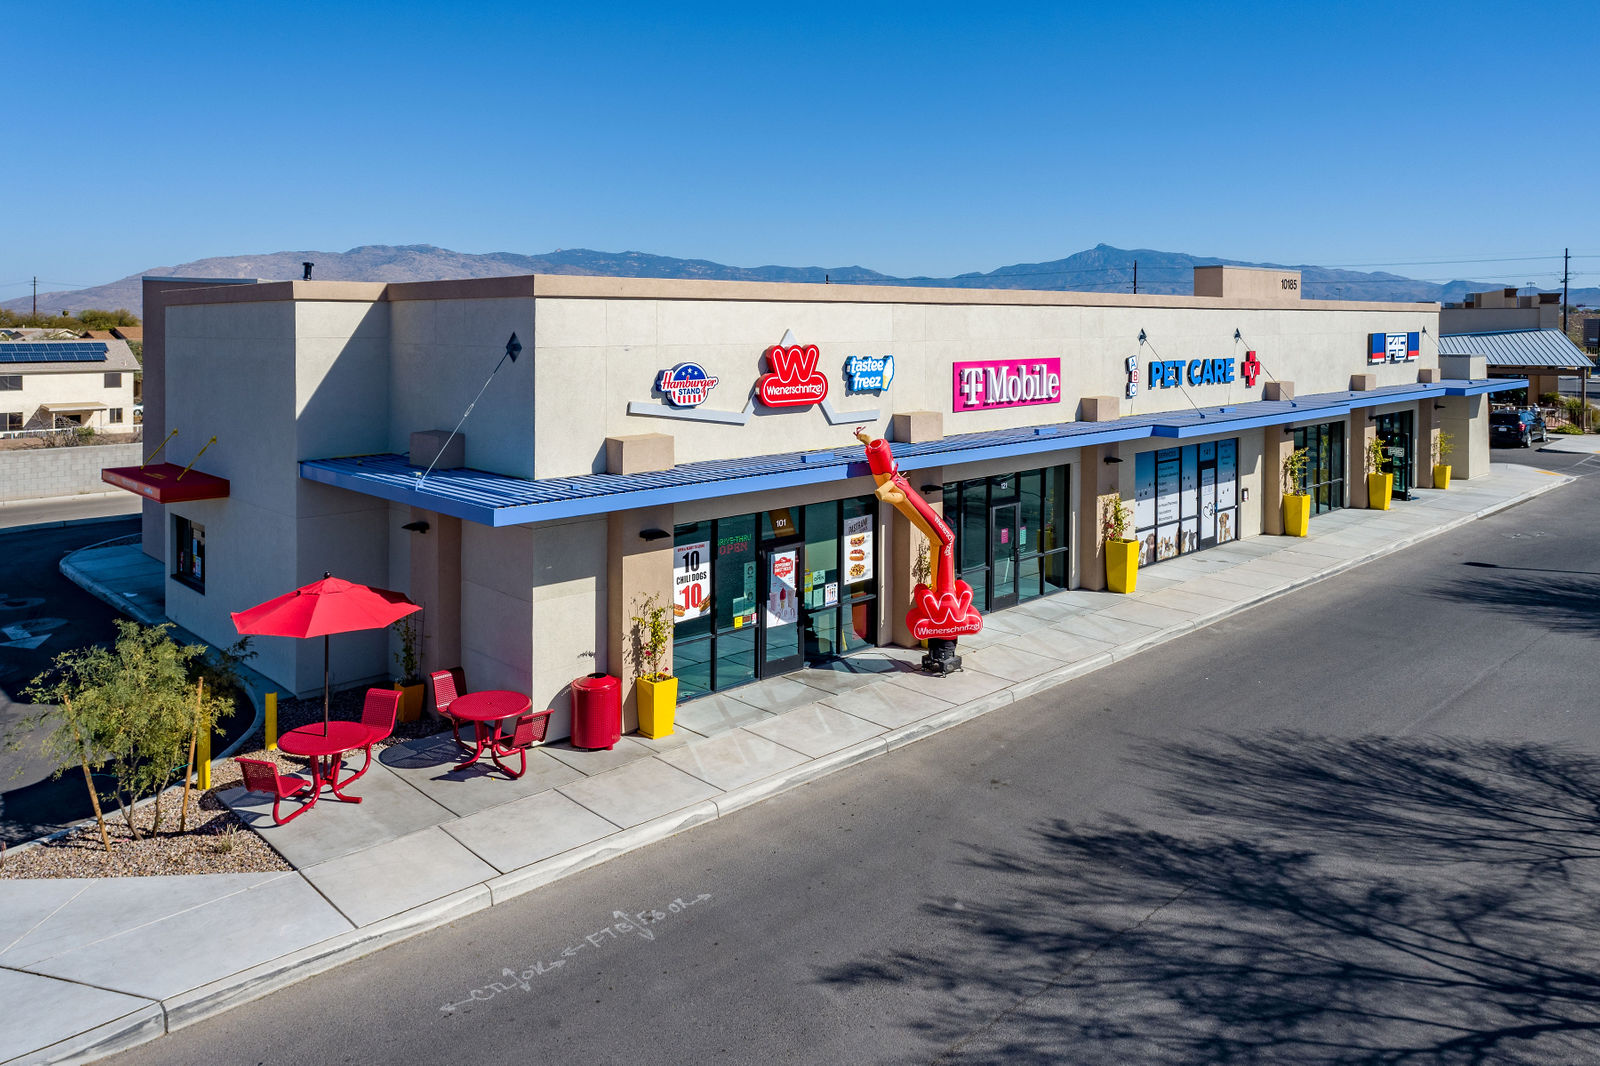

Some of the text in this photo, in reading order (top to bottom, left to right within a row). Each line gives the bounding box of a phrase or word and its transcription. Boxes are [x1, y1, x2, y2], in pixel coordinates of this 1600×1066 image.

[1281, 279, 1298, 290] 10185
[773, 348, 817, 383] W
[851, 357, 884, 375] tastee
[1151, 358, 1235, 388] PET CARE
[662, 371, 717, 396] Hamburger
[766, 382, 824, 396] Wienerschnitzel
[854, 373, 882, 391] freez
[984, 364, 1060, 404] Mobile
[678, 387, 701, 396] STAND
[776, 518, 787, 528] 101
[719, 542, 748, 556] OPEN
[682, 550, 700, 573] 10
[691, 571, 708, 582] DOGS
[923, 591, 972, 625] W
[917, 622, 980, 636] Wienerschnitzel
